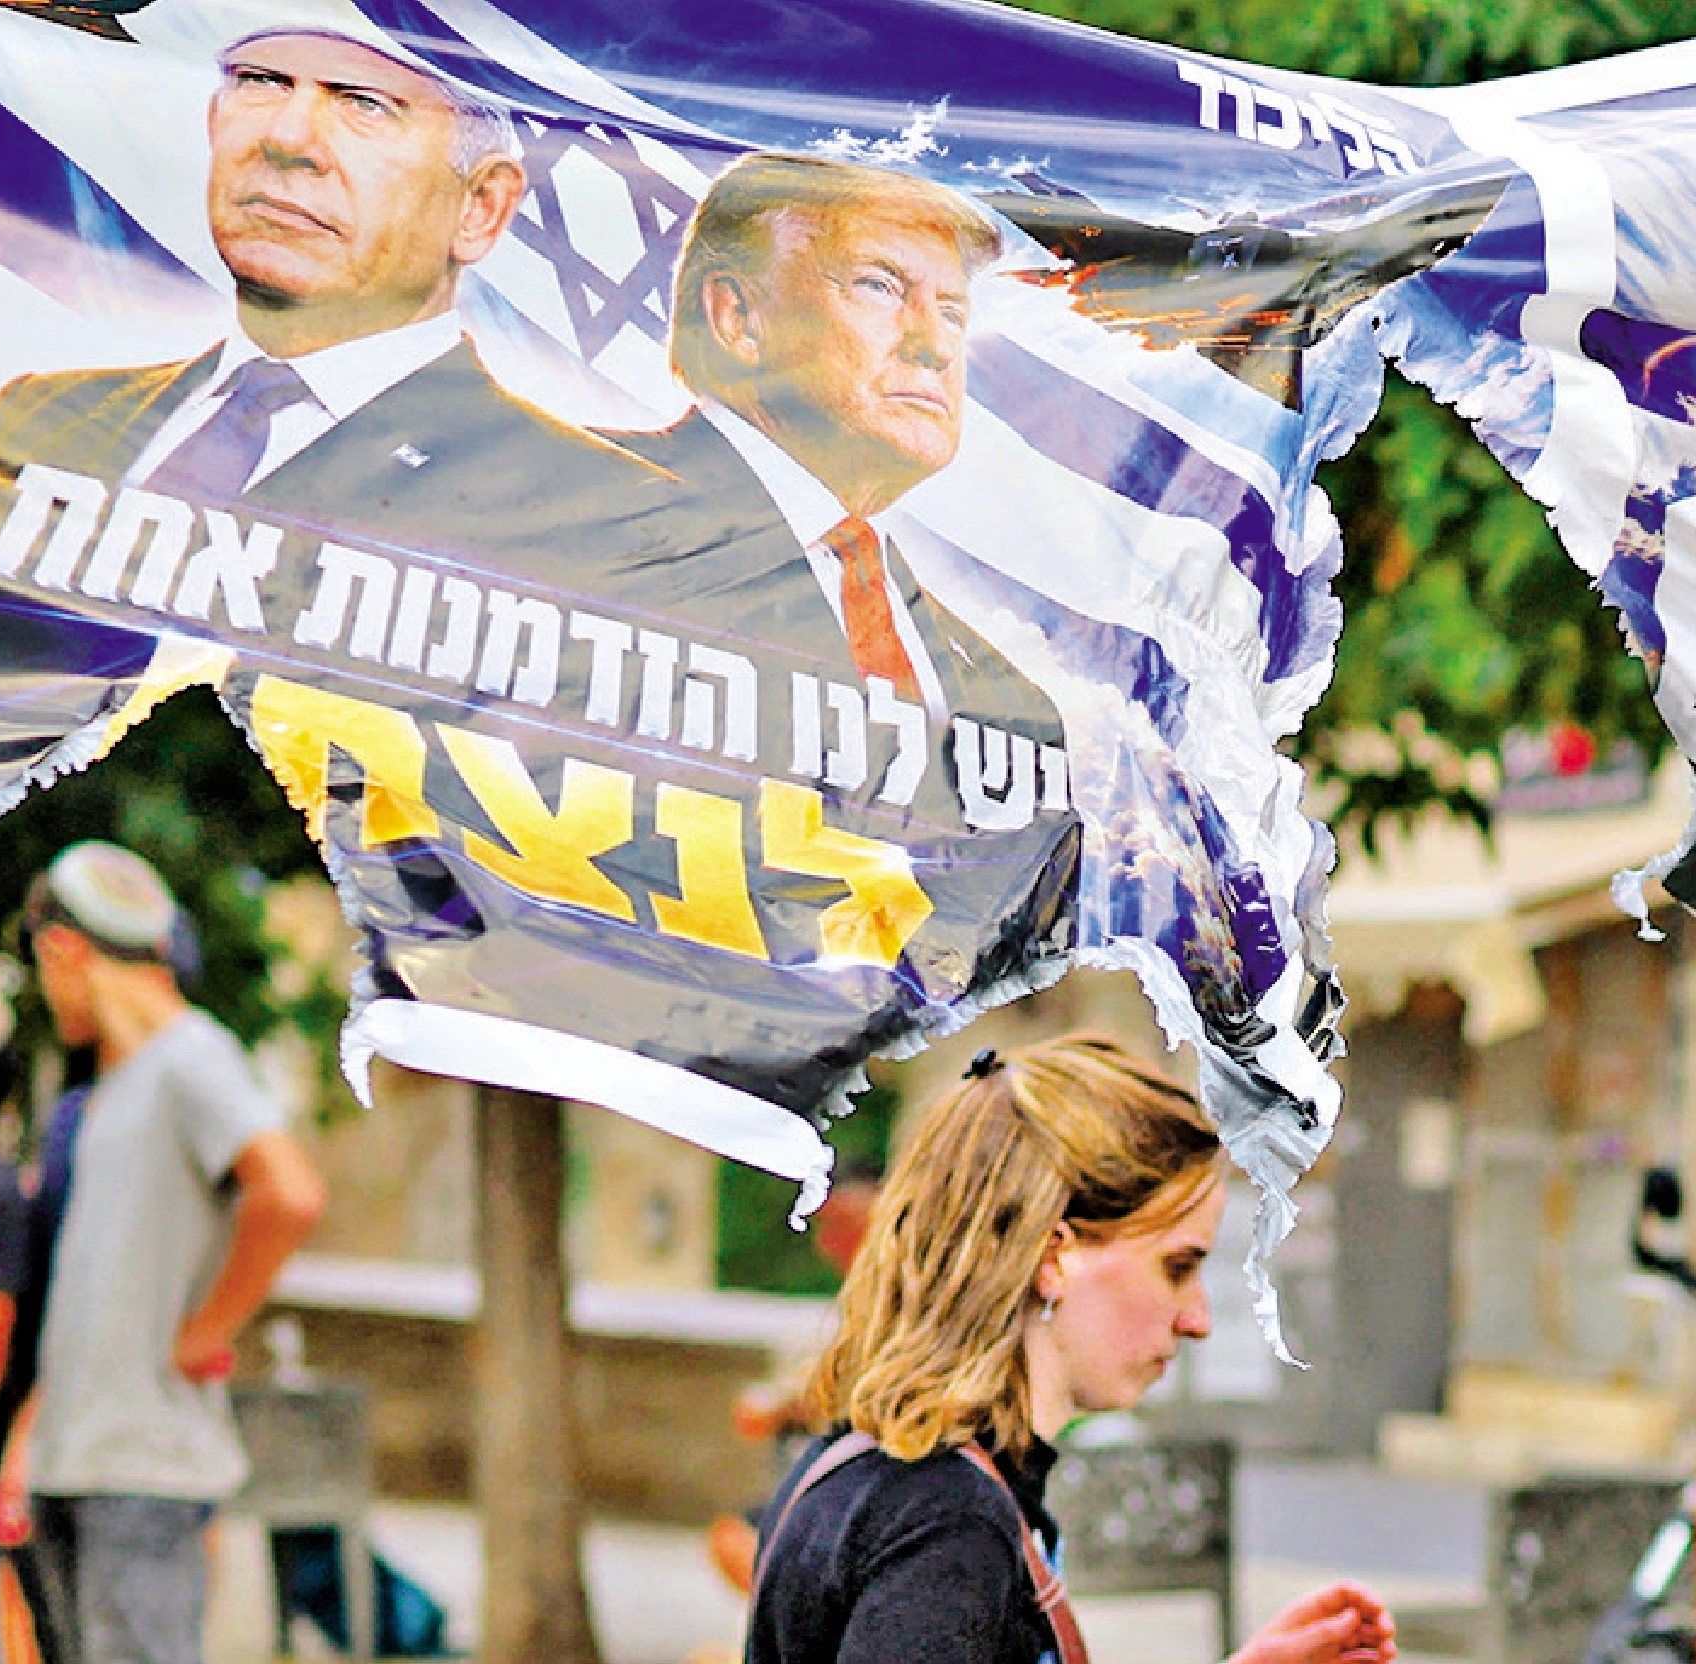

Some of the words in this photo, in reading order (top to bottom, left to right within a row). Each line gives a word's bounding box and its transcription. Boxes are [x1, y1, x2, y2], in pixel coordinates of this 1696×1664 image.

[294, 541, 757, 763] הזדמנות
[790, 671, 929, 805] לנו
[952, 713, 1070, 830] יש
